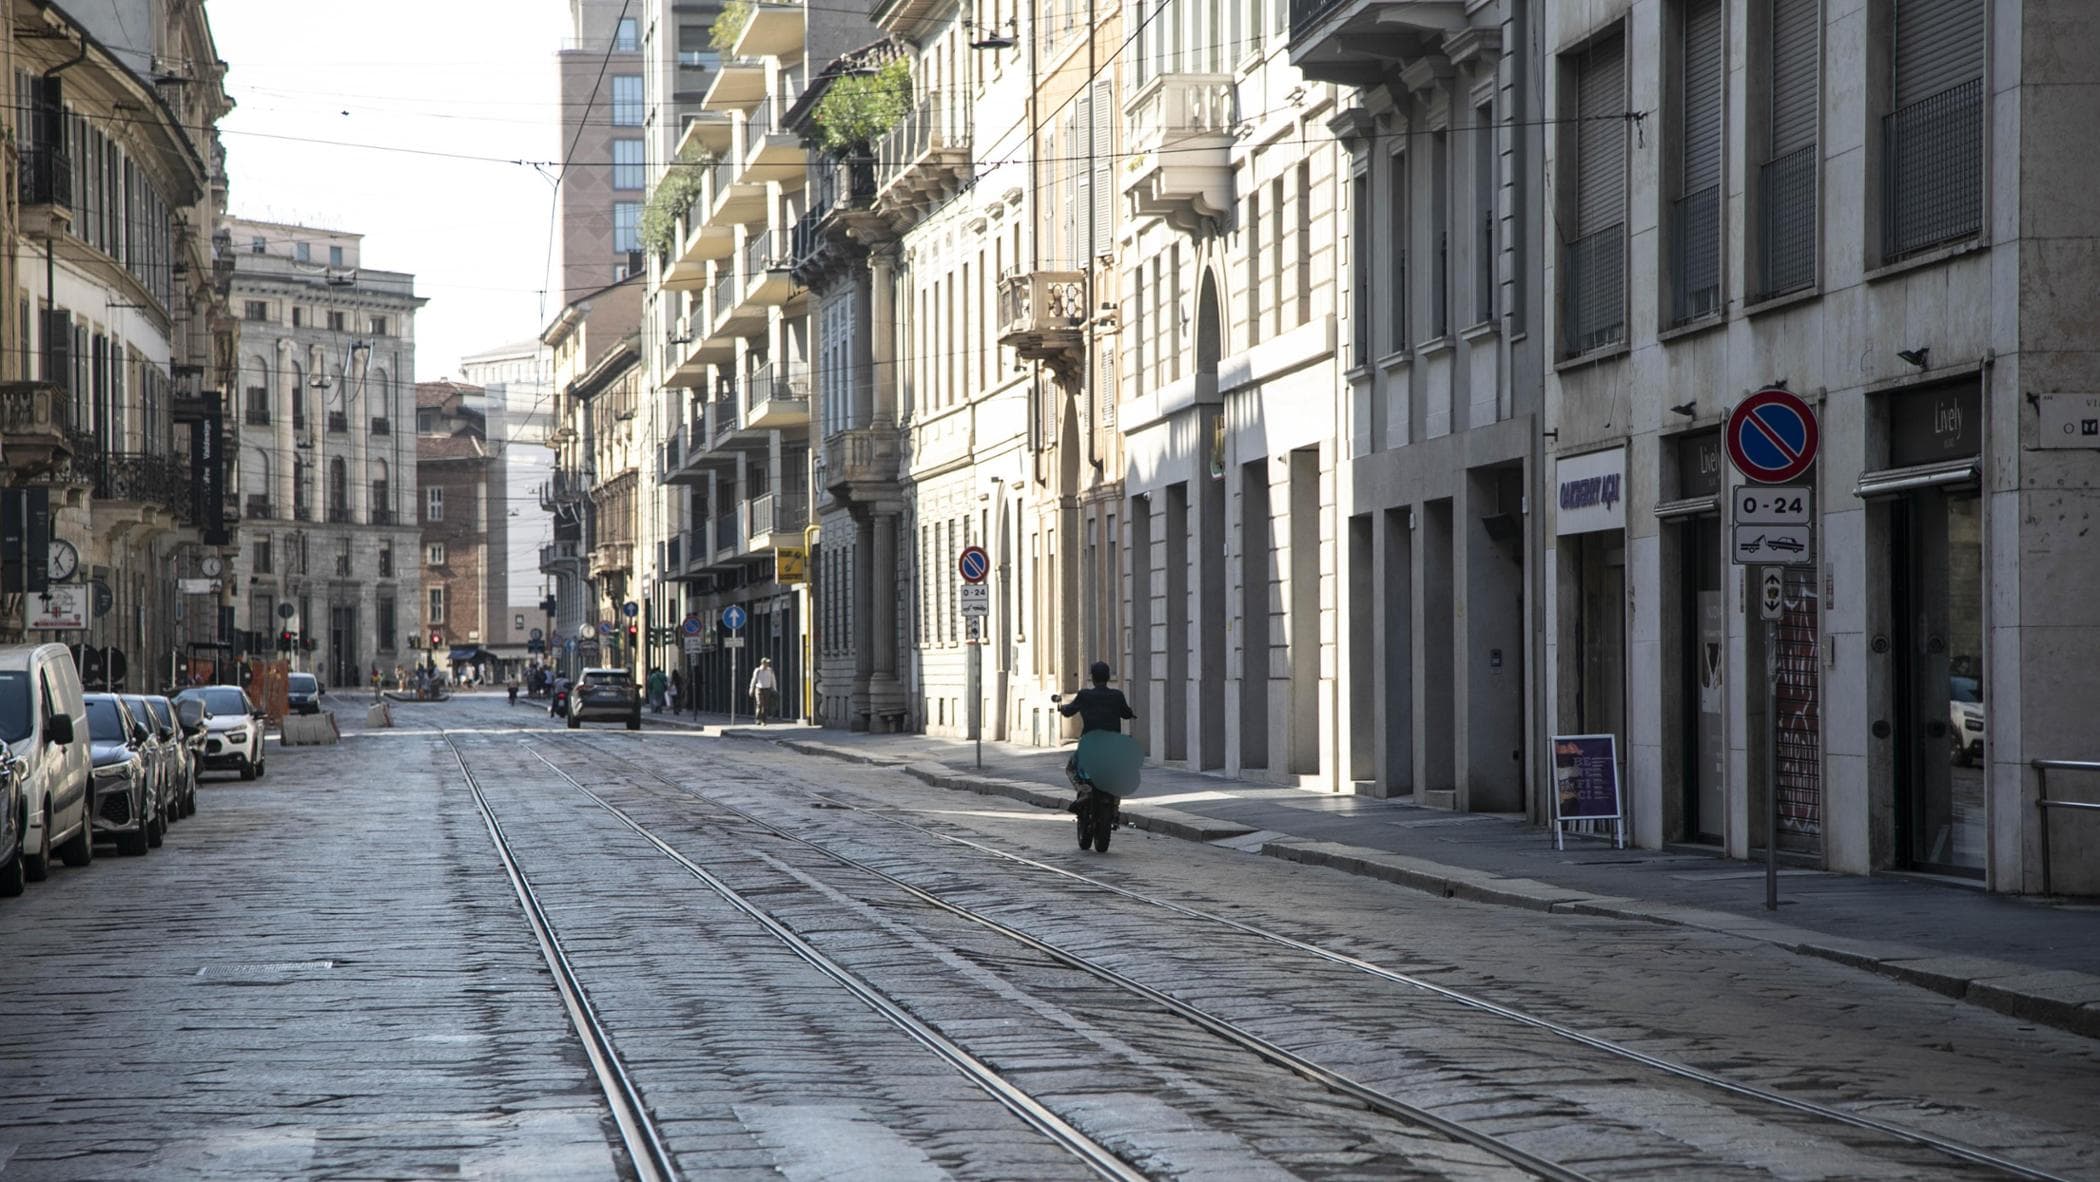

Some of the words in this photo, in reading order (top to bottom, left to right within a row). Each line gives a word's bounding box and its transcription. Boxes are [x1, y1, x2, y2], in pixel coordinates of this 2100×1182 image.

[2086, 399, 2100, 407] VI
[1935, 396, 1963, 440] Lively
[1774, 497, 1803, 514] 24
